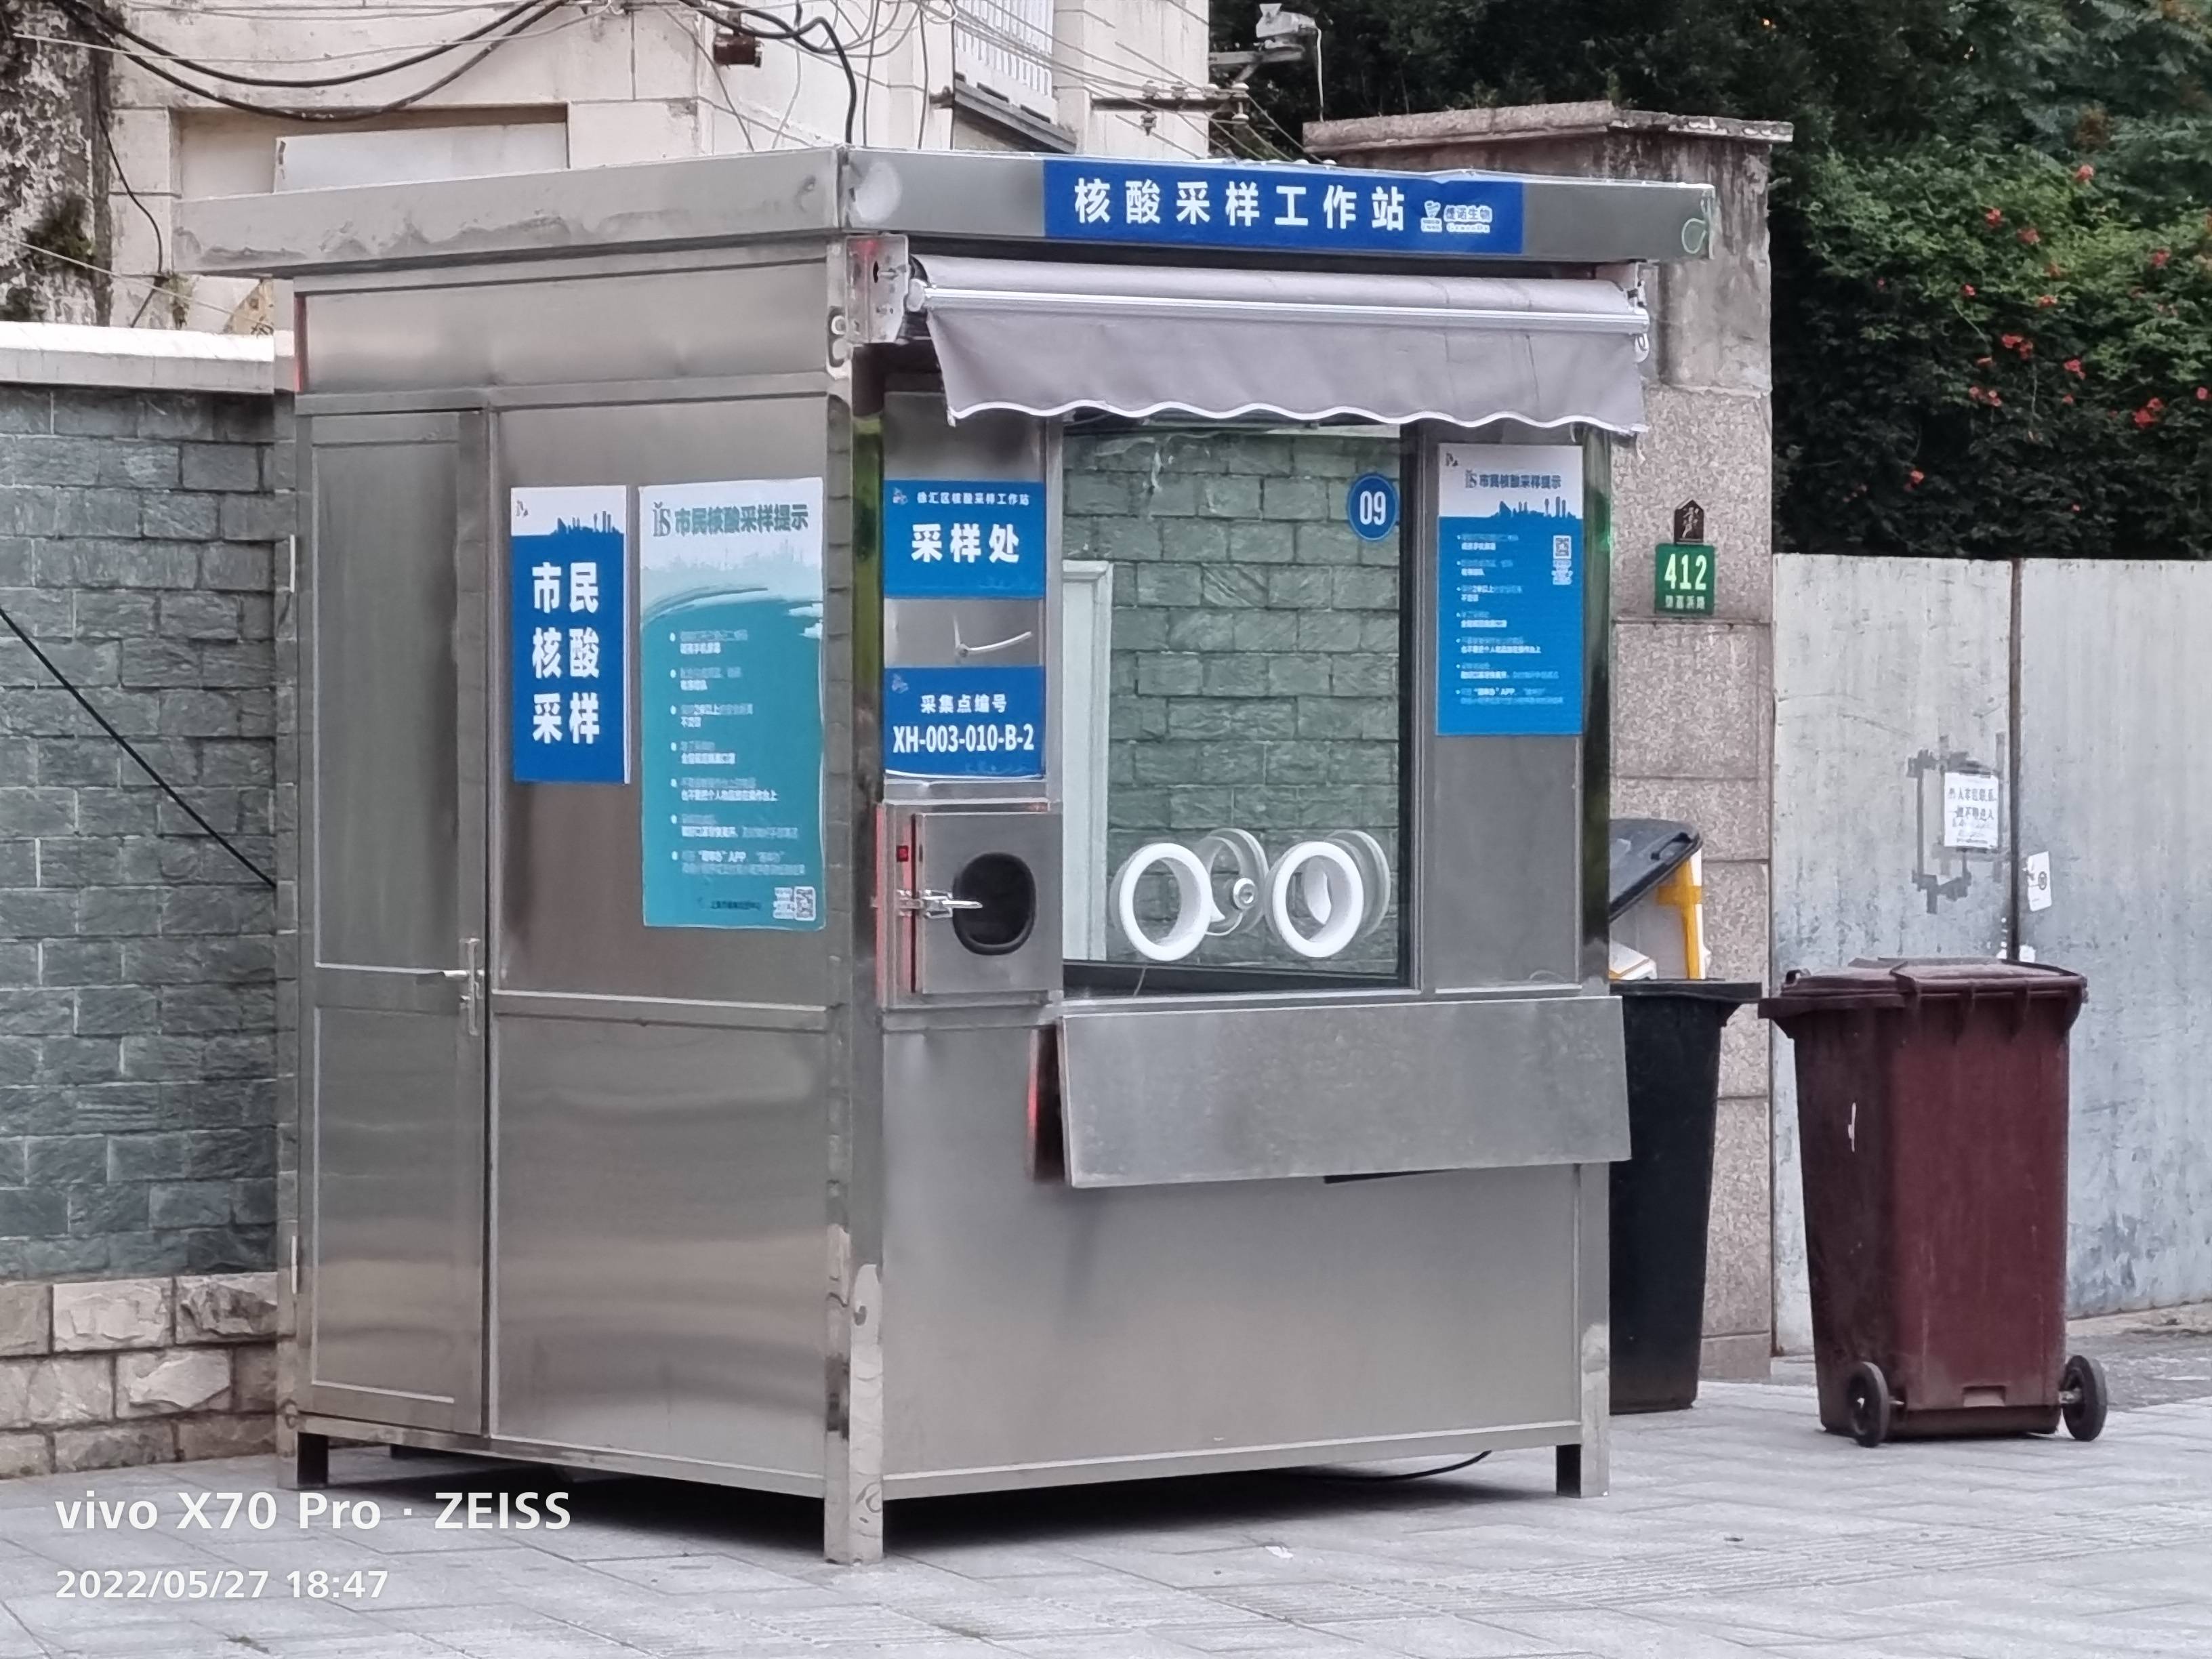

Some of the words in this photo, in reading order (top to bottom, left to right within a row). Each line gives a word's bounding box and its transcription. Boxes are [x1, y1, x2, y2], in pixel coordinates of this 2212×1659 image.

[1074, 178, 1405, 231] 核酸采样工作站
[916, 491, 1030, 506] 徐汇区核酸采样工作站
[1359, 491, 1387, 525] 09
[675, 504, 808, 537] 市民核酸采样提示
[912, 523, 1019, 563] 采样处
[532, 561, 599, 614] 市民
[1664, 553, 1707, 590] 412
[532, 626, 600, 679] 核酸
[532, 691, 600, 744] 采样
[920, 694, 1007, 714] 采集点编号
[893, 723, 1034, 753] XH-003-010-B-2
